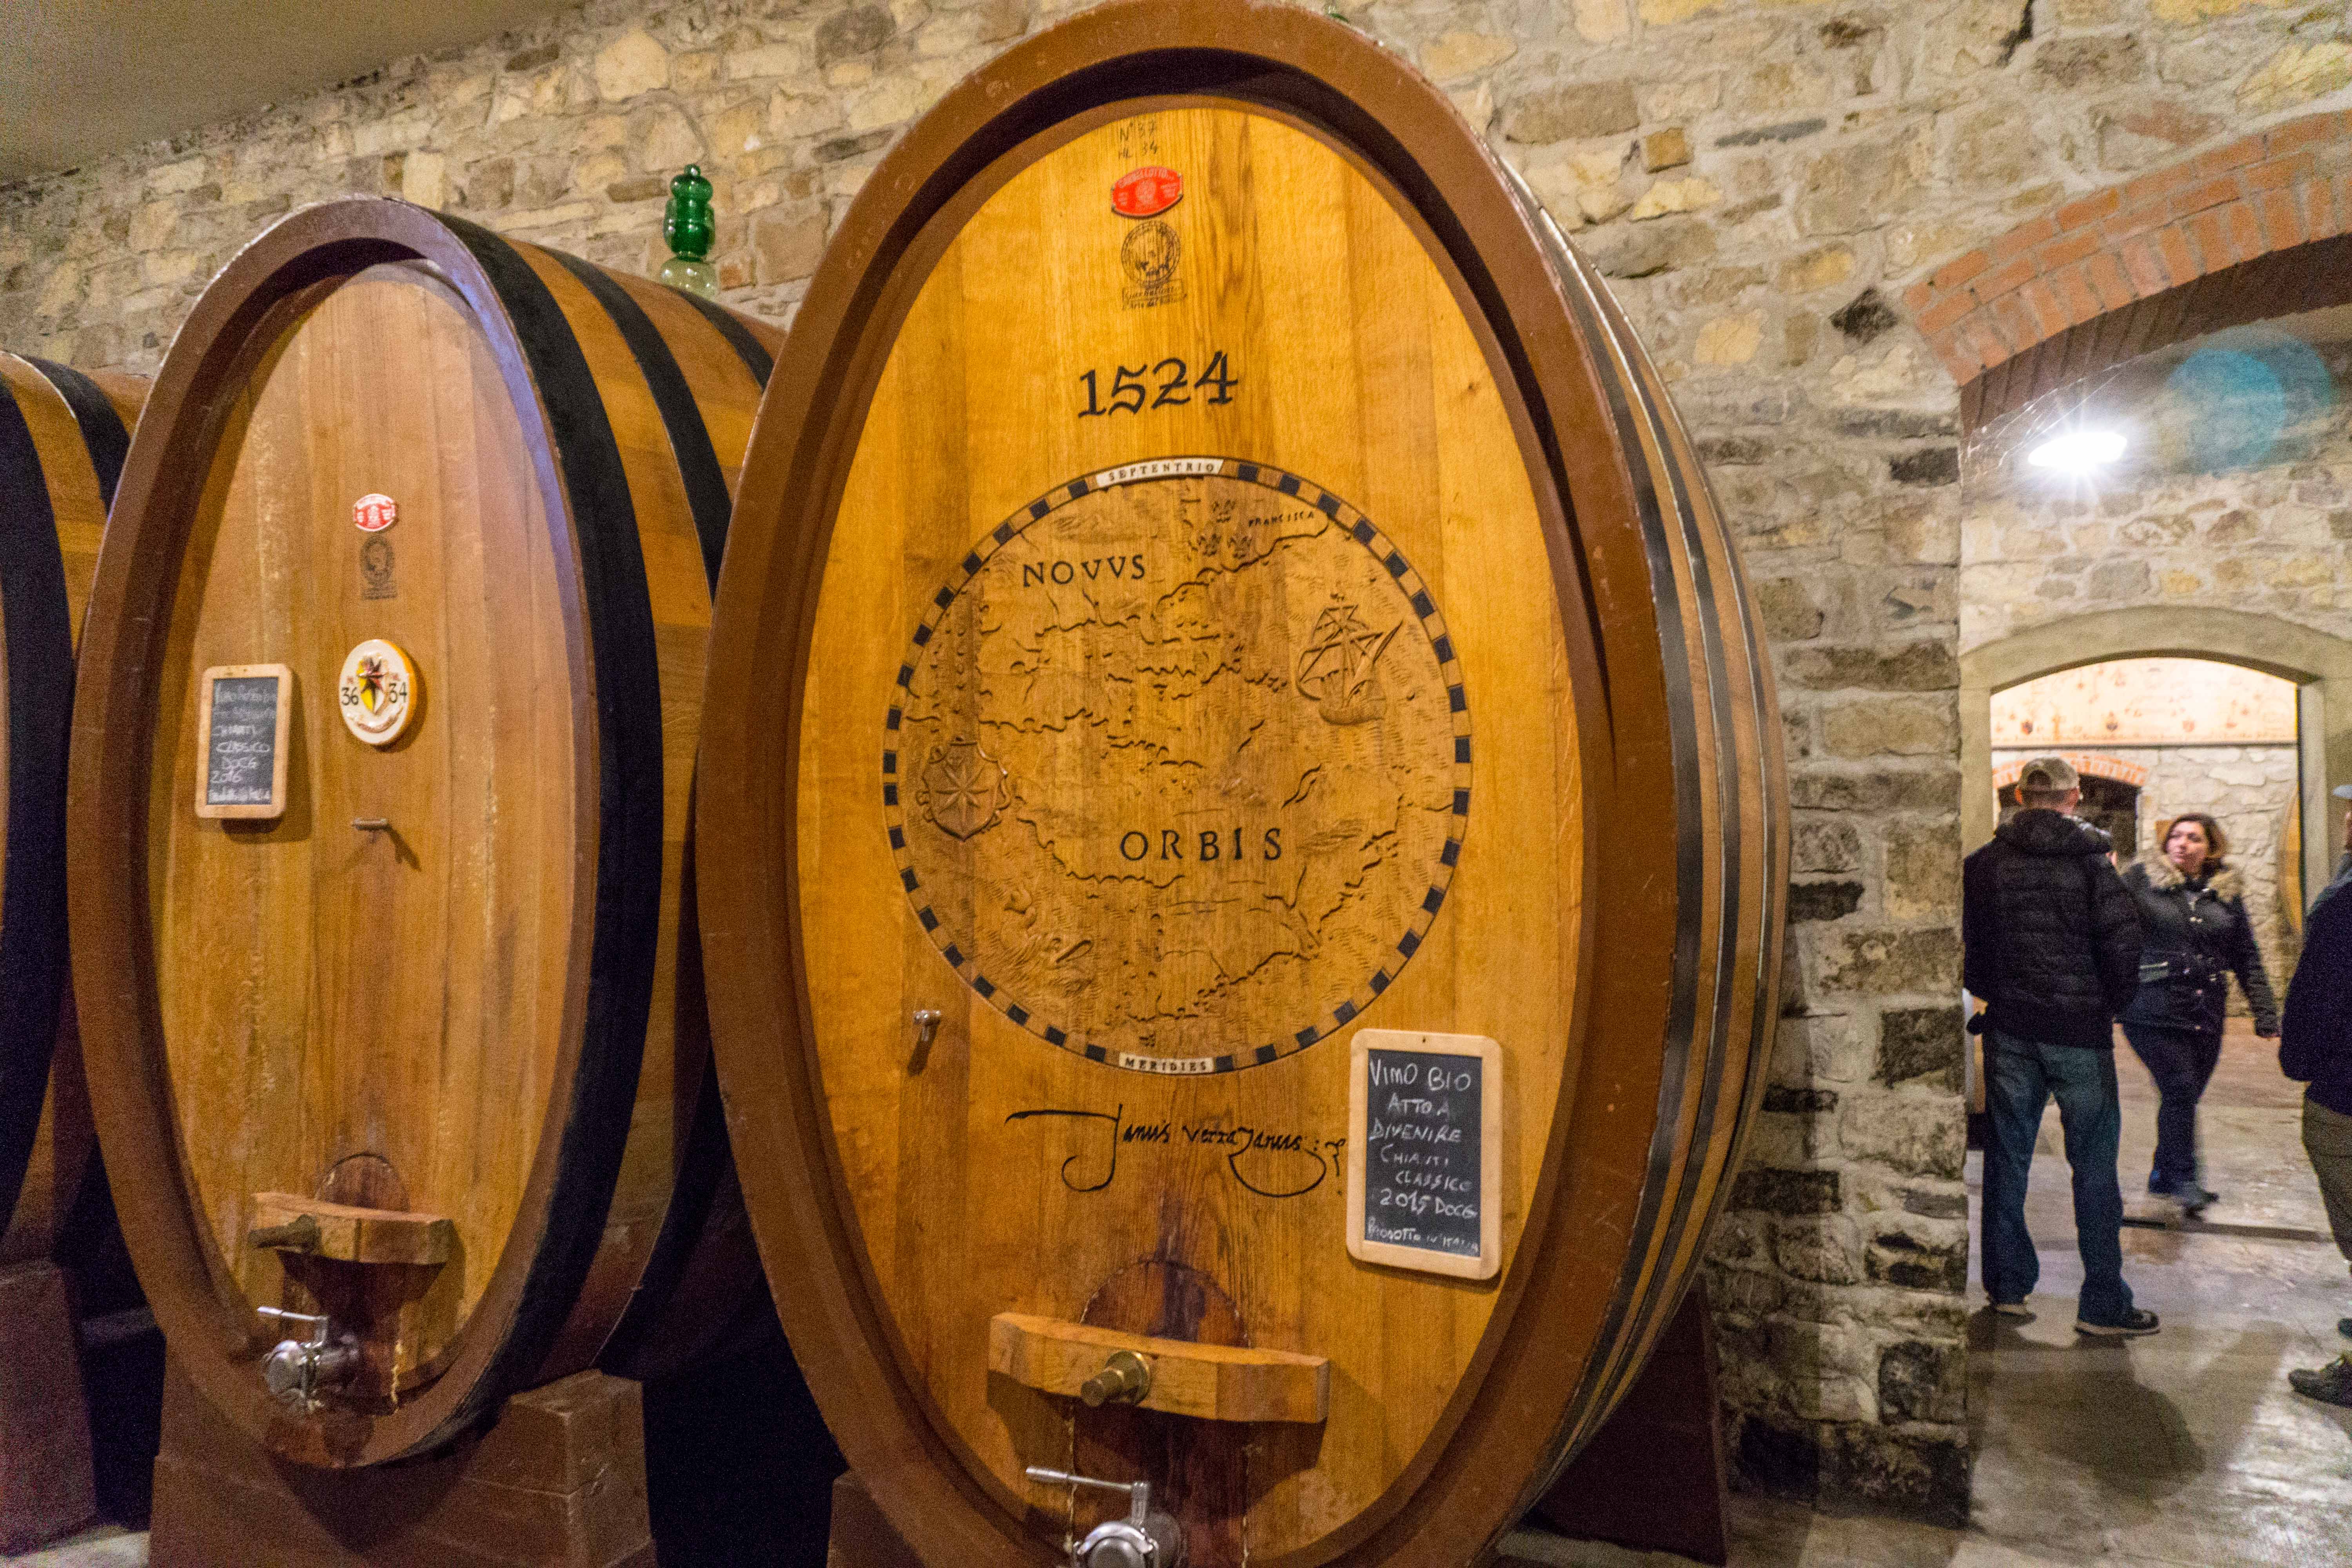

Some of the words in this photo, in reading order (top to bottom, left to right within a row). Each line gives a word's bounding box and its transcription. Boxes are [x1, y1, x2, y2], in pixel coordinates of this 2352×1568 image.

[1078, 351, 1238, 418] 1524
[1108, 463, 1214, 481] SEPTENTRIO
[1023, 554, 1145, 587] NOVVS
[341, 687, 359, 705] 36
[389, 682, 407, 703] 34
[1120, 828, 1282, 861] ORBIS
[1125, 1057, 1206, 1071] MERIDIES
[1428, 1066, 1471, 1091] BIO
[1388, 1092, 1432, 1114] ATTO
[1368, 1117, 1461, 1143] DIVENIRE
[1395, 1171, 1472, 1192] CLASSICO
[1380, 1187, 1431, 1215] 2015
[1435, 1196, 1478, 1219] DOCG
